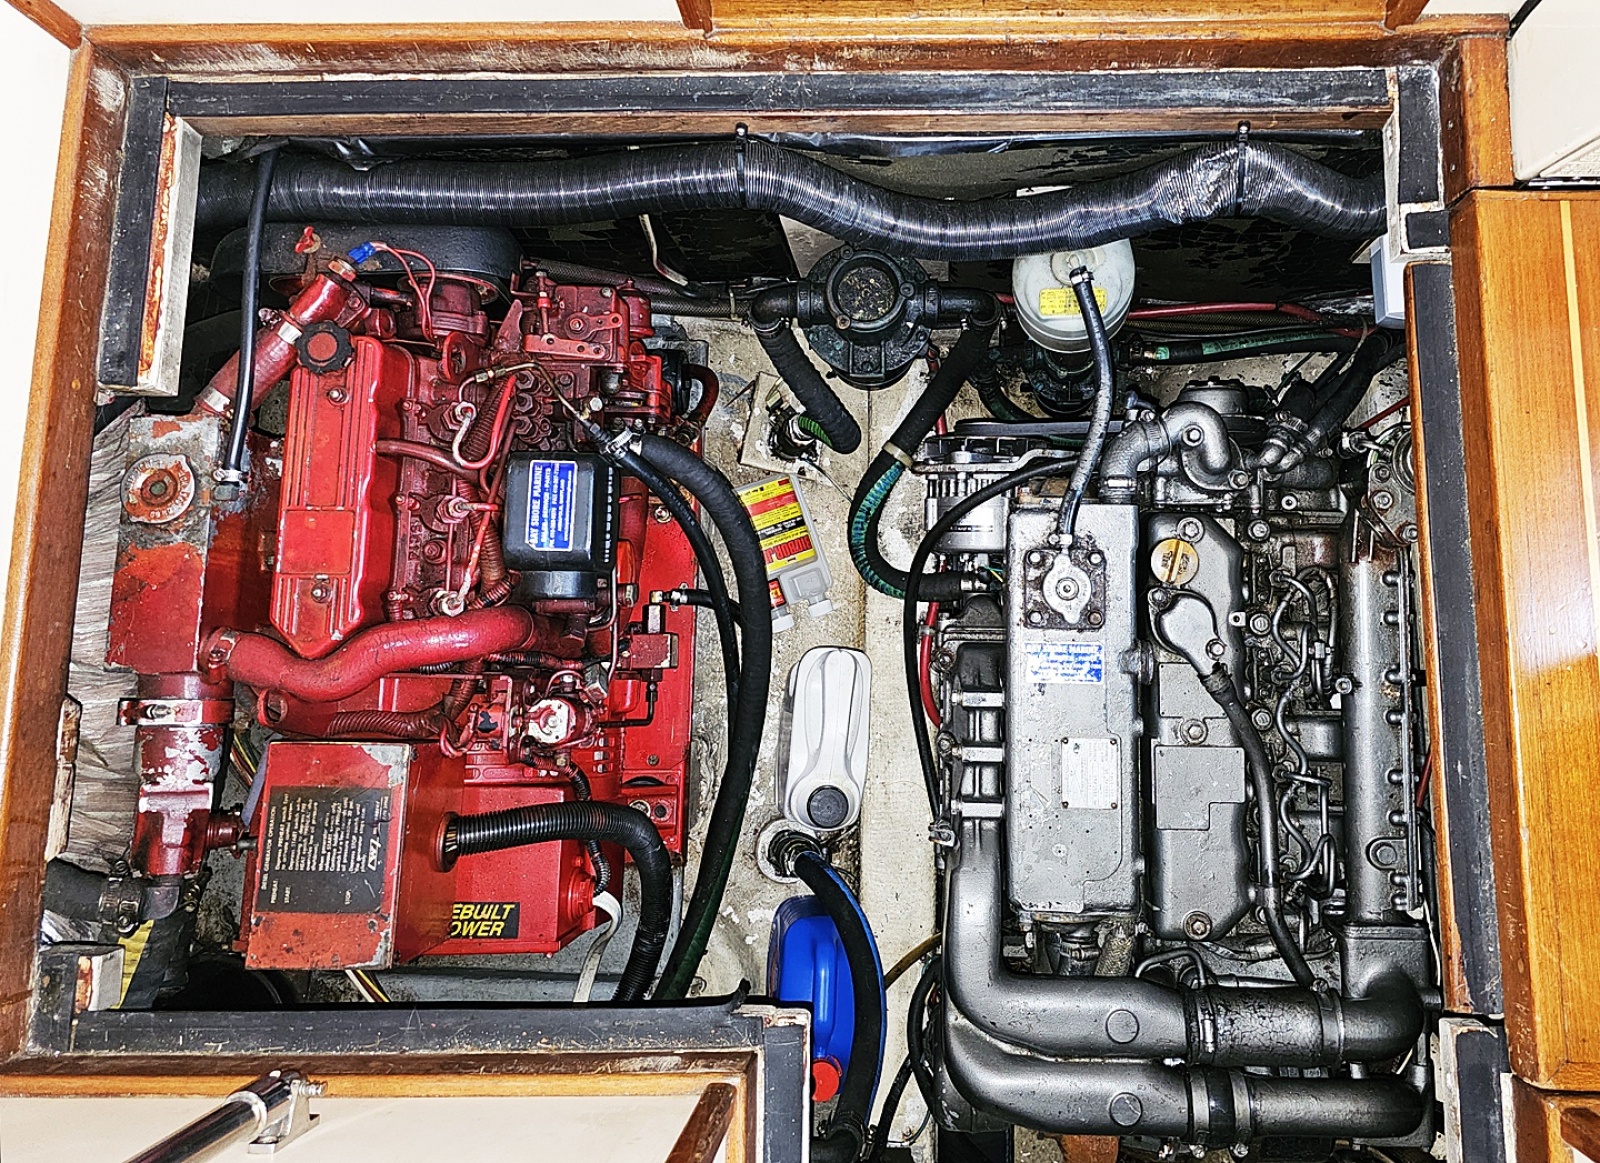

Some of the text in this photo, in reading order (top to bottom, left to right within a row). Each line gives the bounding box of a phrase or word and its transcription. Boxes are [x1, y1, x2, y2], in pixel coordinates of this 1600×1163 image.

[533, 465, 542, 497] MARINE
[531, 499, 540, 526] SHORE
[264, 839, 272, 871] GENERATOR
[268, 806, 276, 837] OPERATION
[452, 904, 516, 920] EBUILT
[450, 921, 505, 937] OWER
